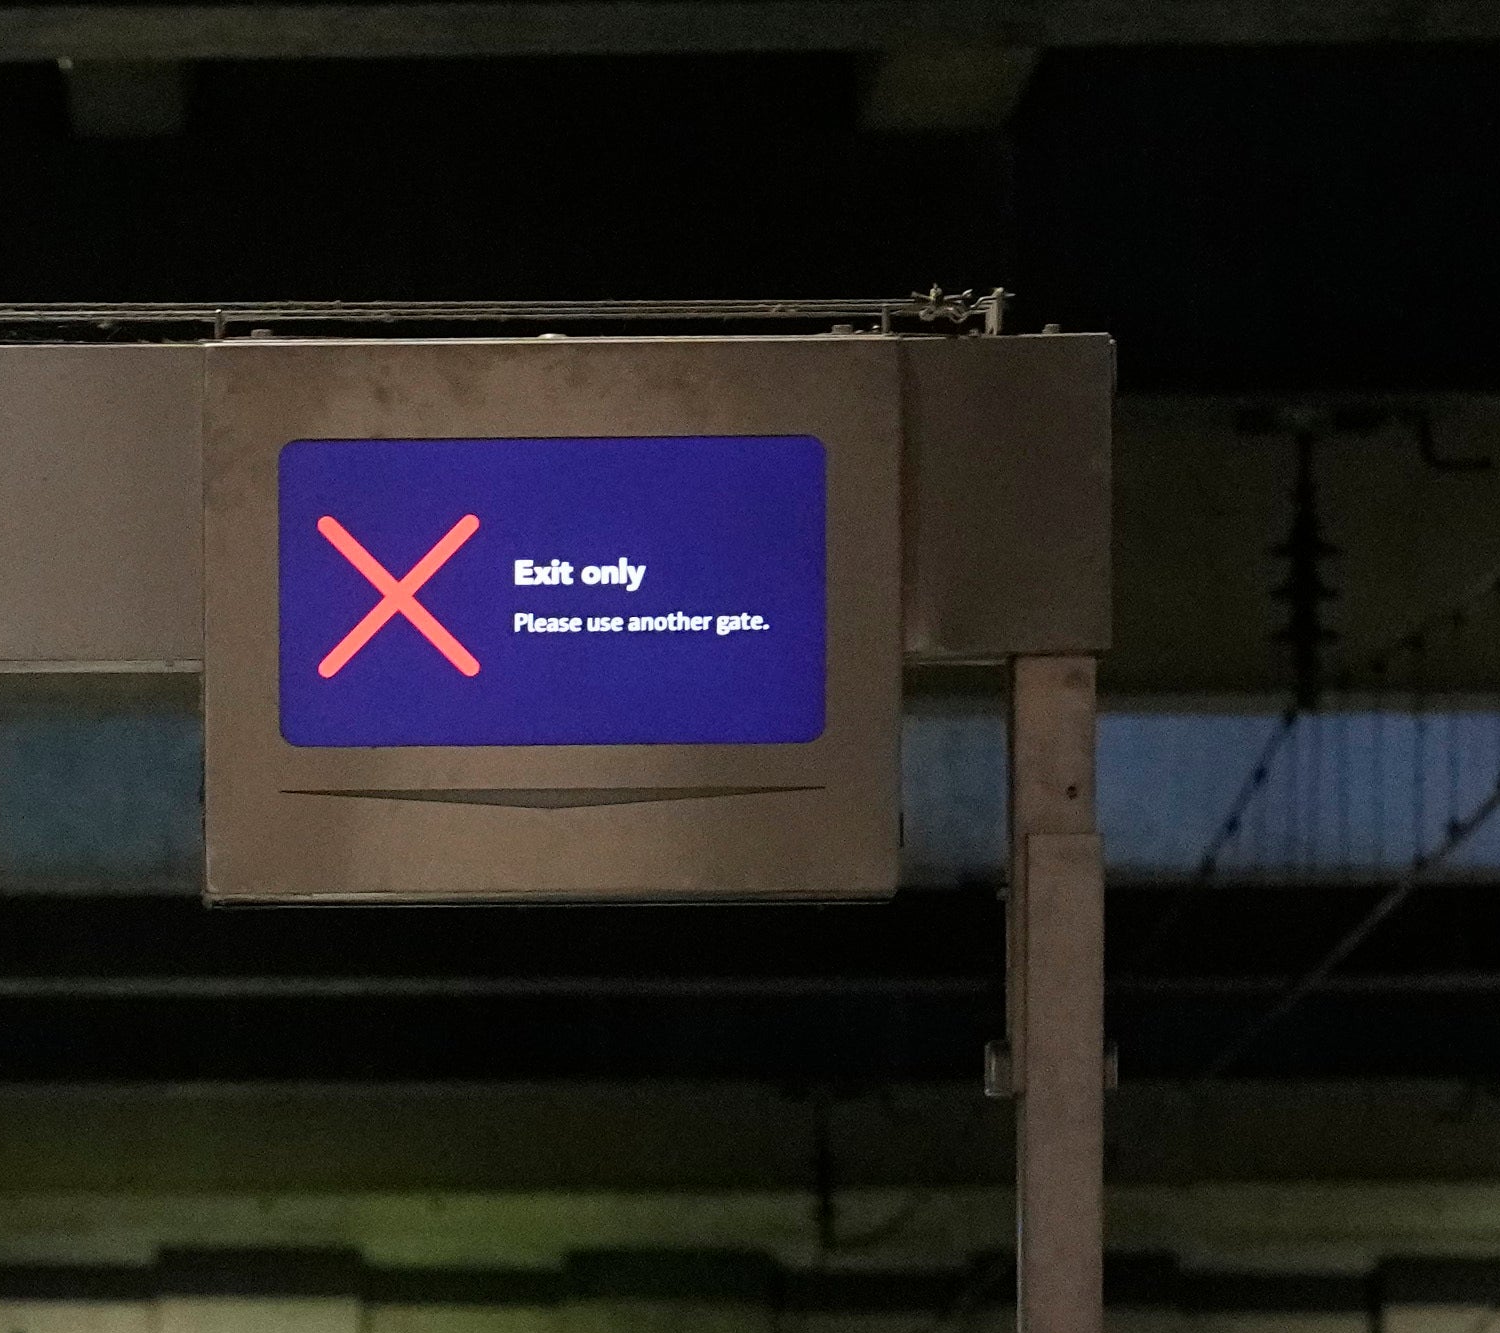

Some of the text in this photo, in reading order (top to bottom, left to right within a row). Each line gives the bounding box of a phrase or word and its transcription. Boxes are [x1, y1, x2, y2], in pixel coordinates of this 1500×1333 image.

[515, 557, 646, 591] Exit only
[514, 612, 769, 635] Please use another gate.
